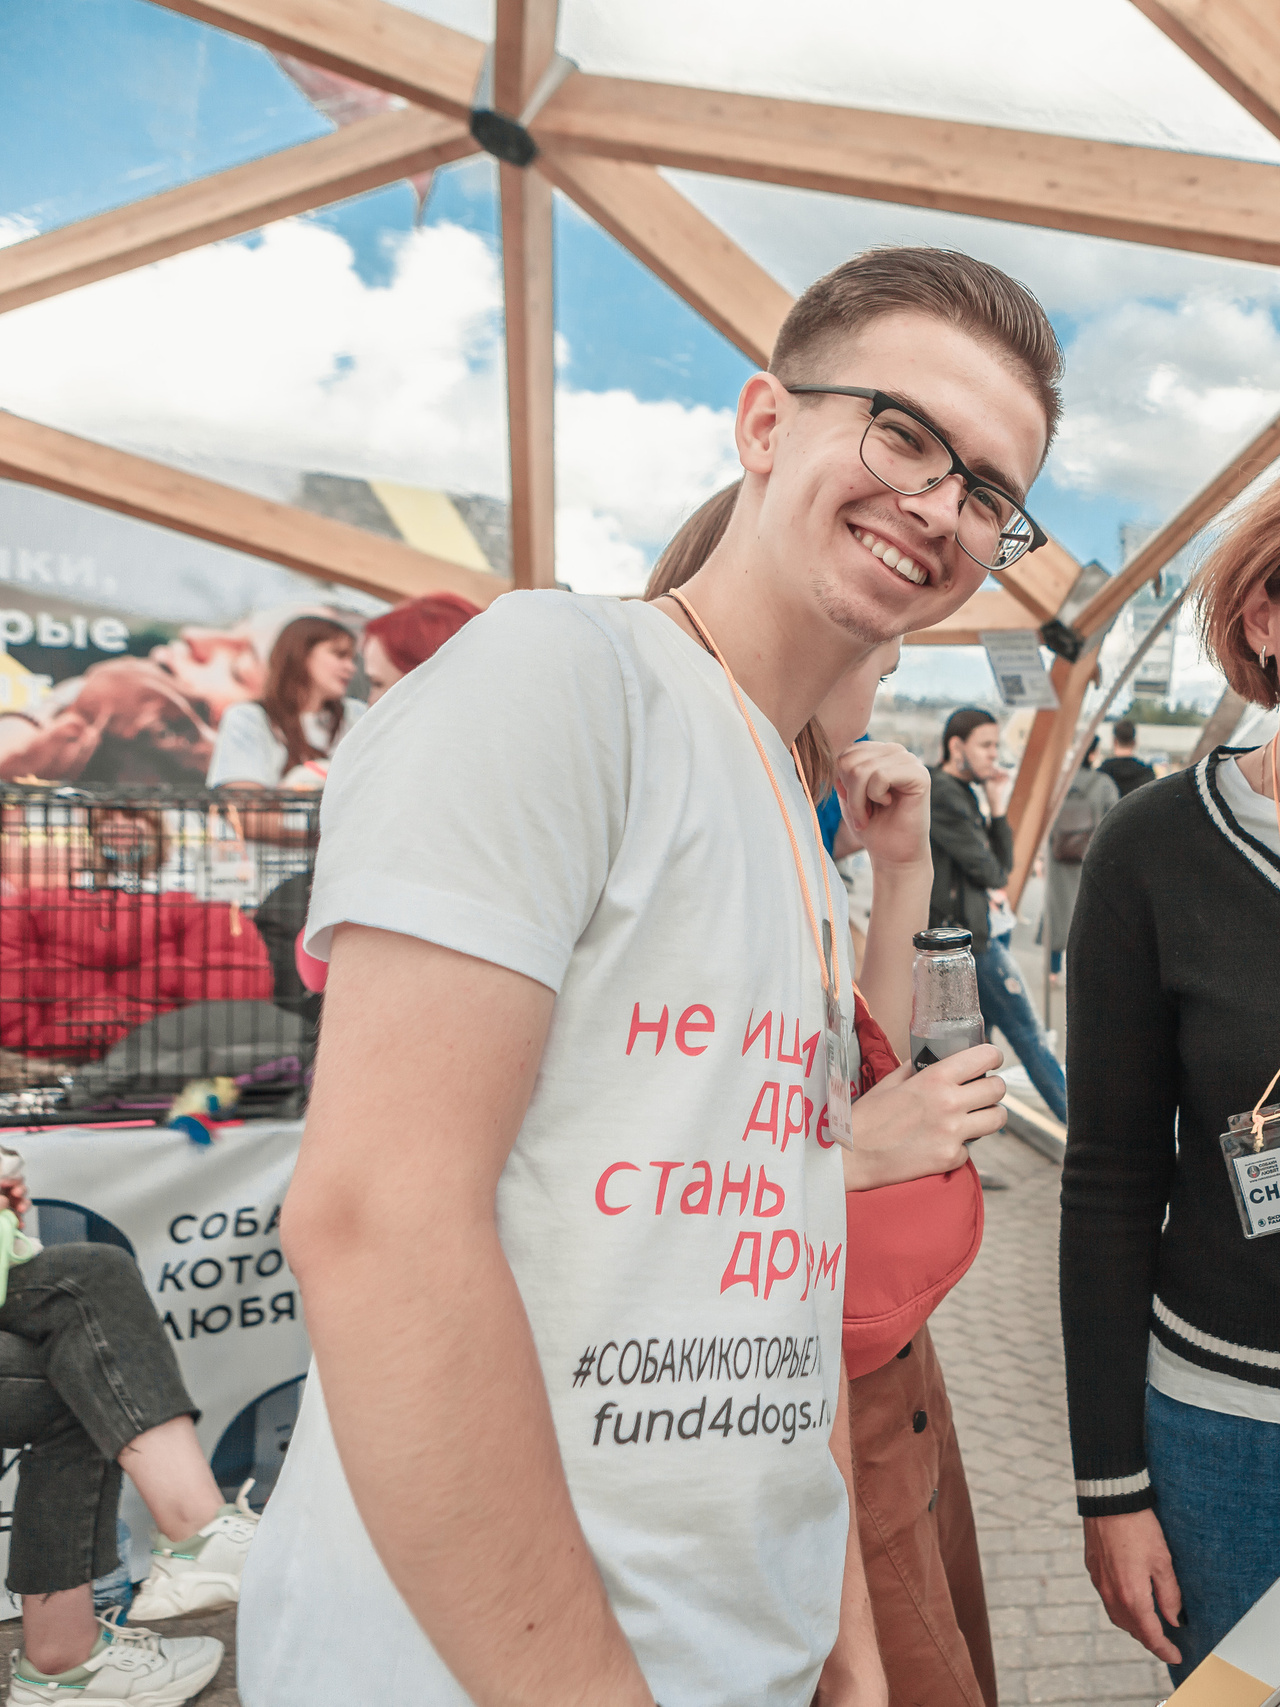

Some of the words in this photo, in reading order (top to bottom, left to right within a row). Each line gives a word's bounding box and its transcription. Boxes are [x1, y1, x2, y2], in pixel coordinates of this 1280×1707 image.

[0, 549, 118, 596] ки,
[625, 1001, 716, 1057] не
[595, 1160, 786, 1218] стань
[158, 1248, 284, 1293] КОТО
